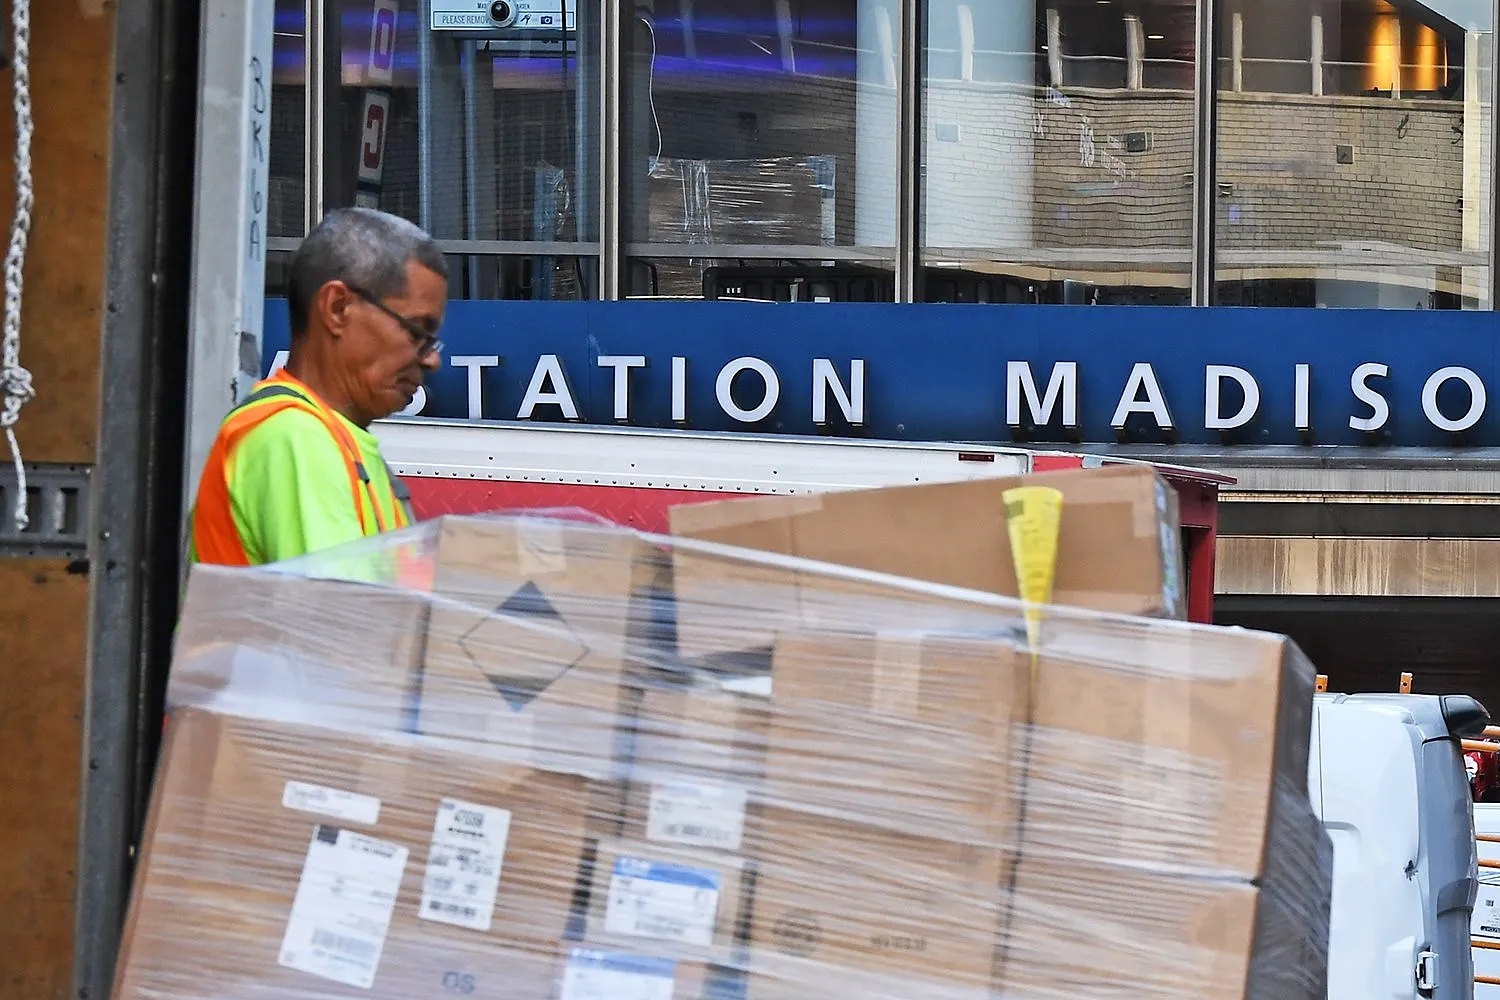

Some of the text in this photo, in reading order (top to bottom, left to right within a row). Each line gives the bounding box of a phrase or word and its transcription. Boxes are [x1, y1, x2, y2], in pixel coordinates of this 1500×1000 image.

[442, 15, 491, 24] PLEASE REMOV
[404, 354, 864, 423] TATION
